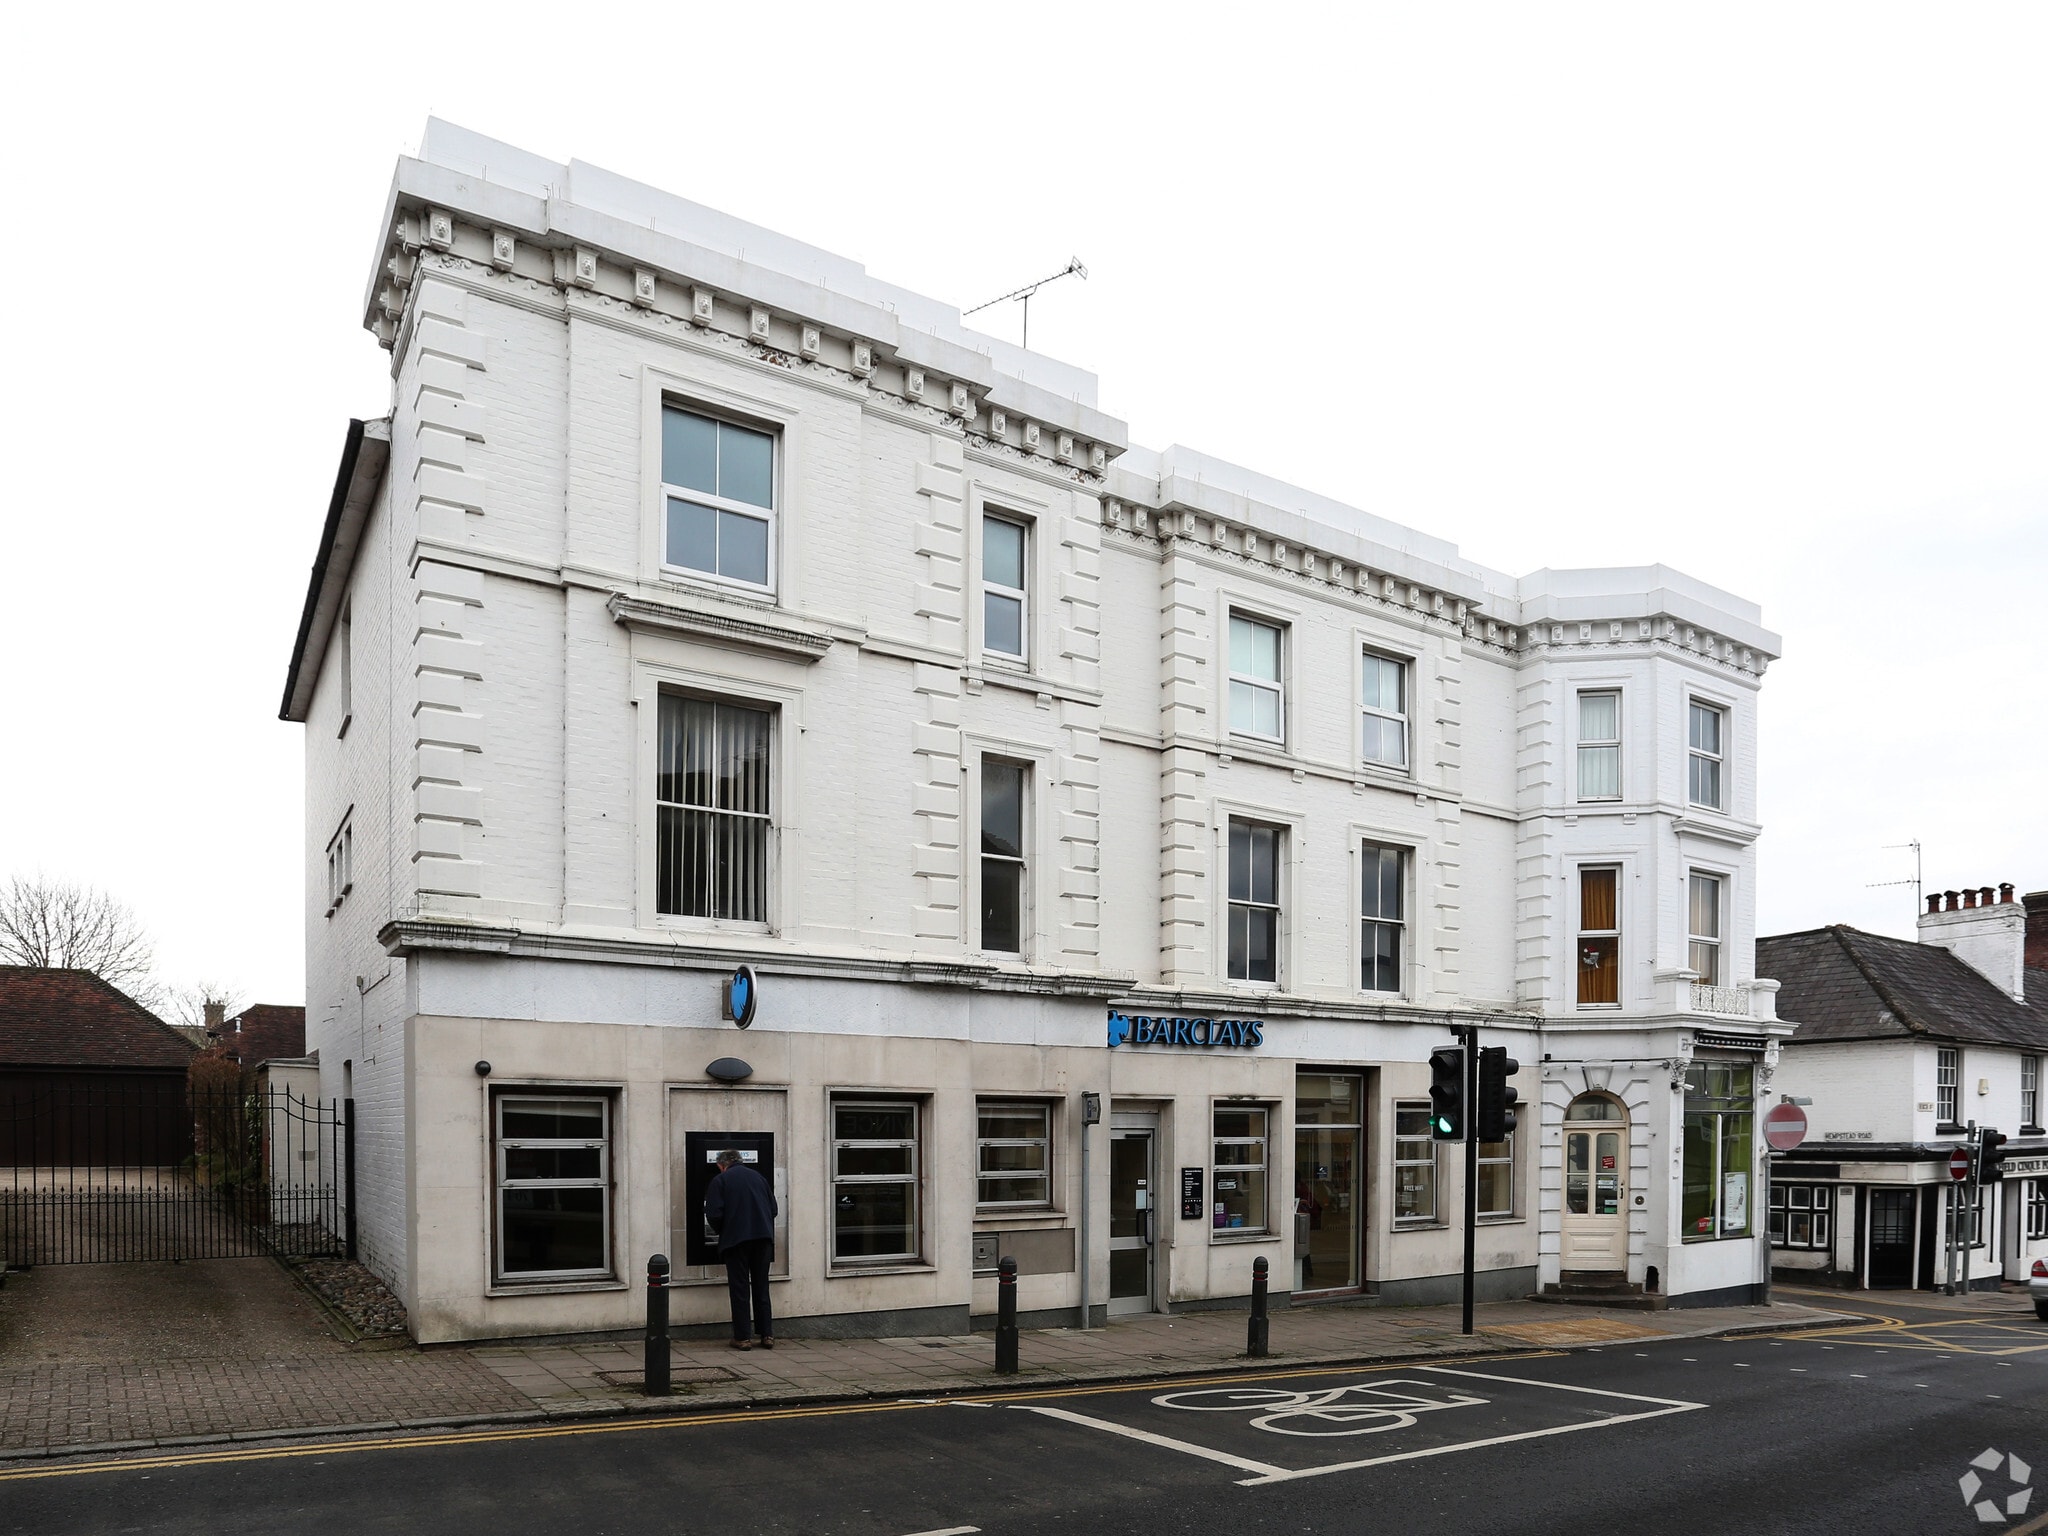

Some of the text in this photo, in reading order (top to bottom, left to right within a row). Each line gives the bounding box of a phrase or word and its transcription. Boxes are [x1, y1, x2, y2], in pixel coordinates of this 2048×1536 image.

[1134, 1016, 1264, 1047] BARCLAYS
[1825, 1132, 1857, 1140] HEMPSTEAD
[2017, 1160, 2041, 1171] CINQUE
